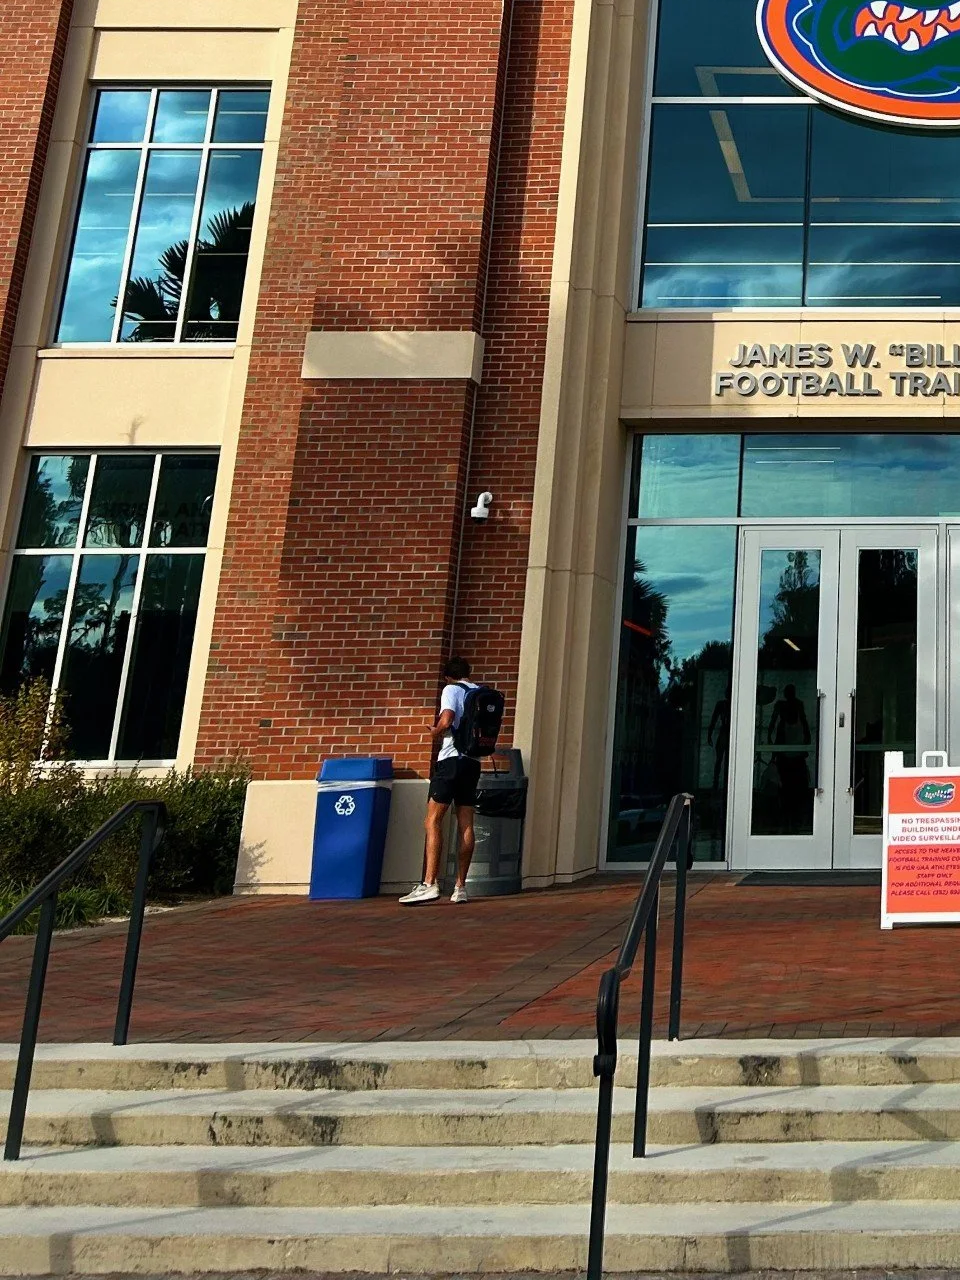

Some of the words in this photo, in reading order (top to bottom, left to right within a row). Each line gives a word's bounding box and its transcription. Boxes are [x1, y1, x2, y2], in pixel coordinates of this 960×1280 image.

[730, 344, 833, 368] JAMES
[840, 344, 881, 368] W.
[715, 372, 882, 397] FOOTBALL
